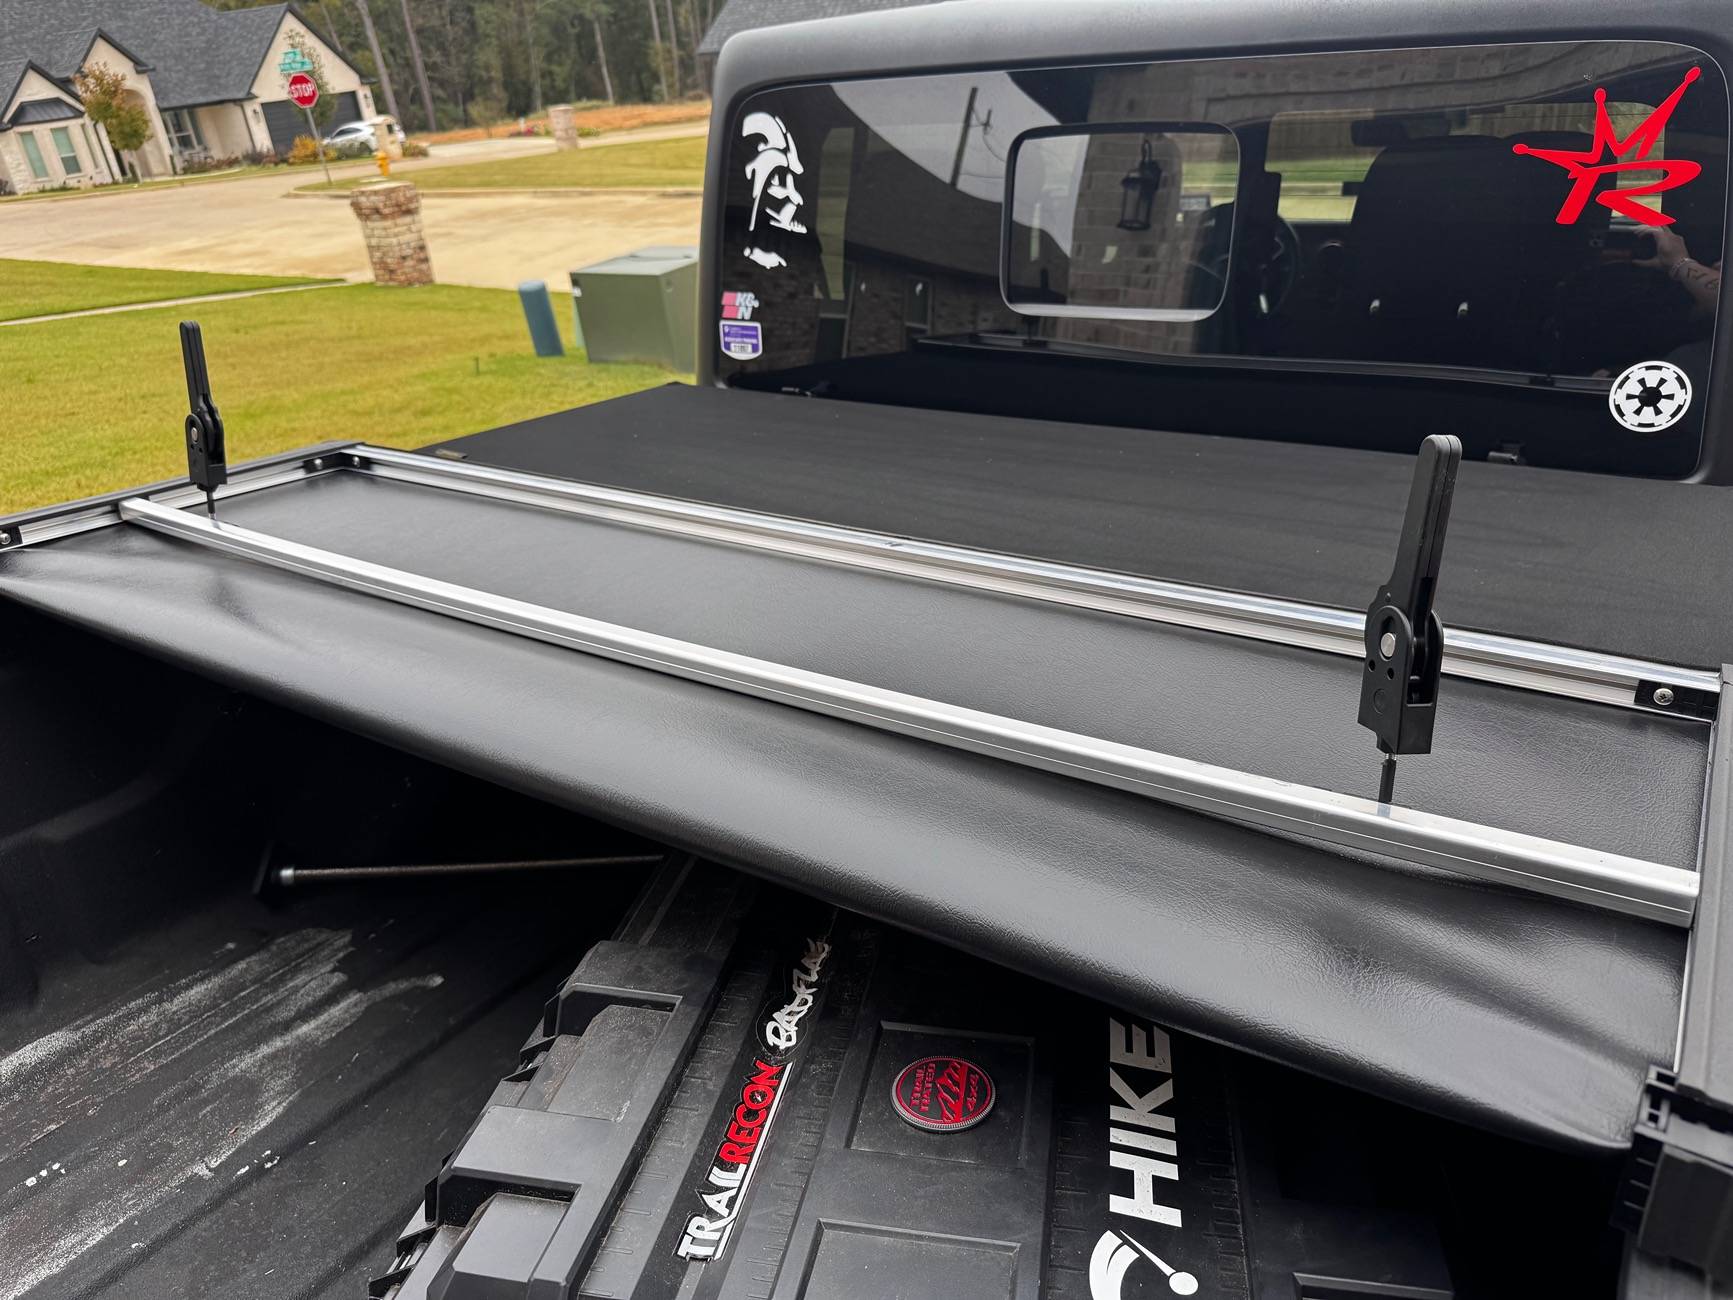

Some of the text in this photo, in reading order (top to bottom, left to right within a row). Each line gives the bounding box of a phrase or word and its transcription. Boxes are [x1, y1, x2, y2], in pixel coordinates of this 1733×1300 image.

[289, 82, 315, 98] STOP
[911, 1066, 926, 1107] TRAIL
[919, 1062, 936, 1112] RATED
[1109, 1017, 1182, 1228] HIKE
